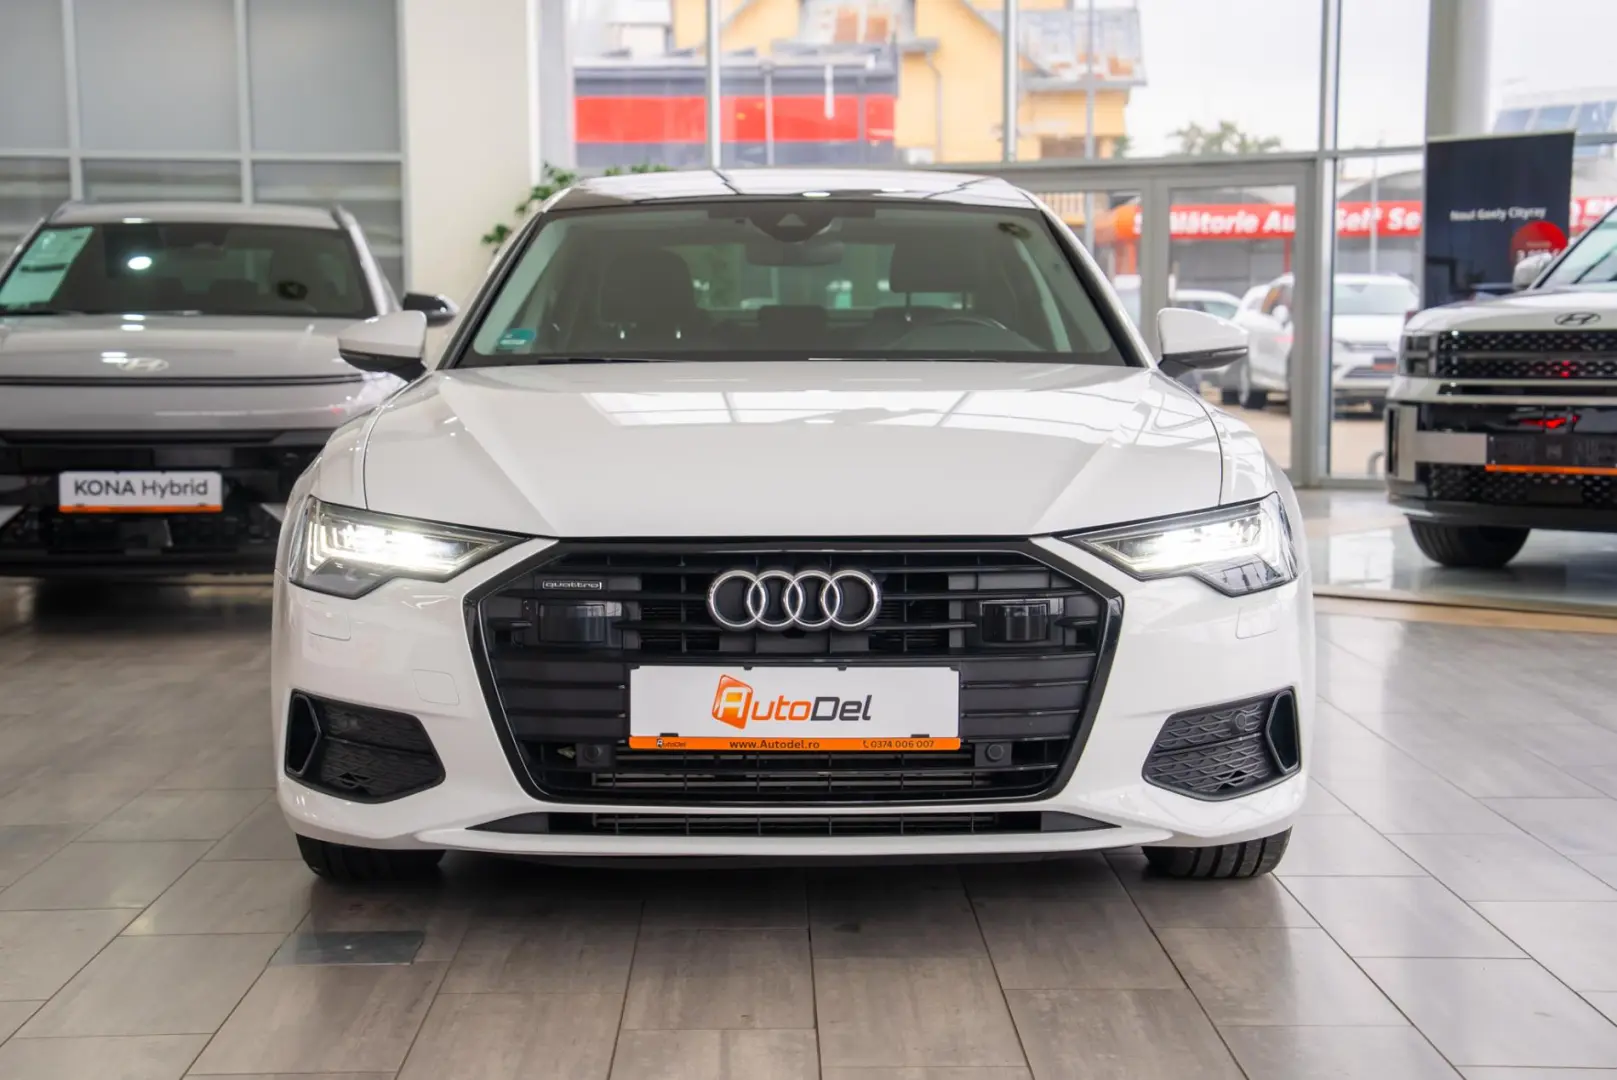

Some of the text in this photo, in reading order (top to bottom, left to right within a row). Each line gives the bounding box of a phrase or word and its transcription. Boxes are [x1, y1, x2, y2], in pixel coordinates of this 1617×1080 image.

[1263, 209, 1295, 234] Au
[1387, 206, 1421, 232] Se
[74, 479, 208, 499] KONA Hybrid
[544, 581, 600, 590] quattro
[713, 680, 873, 725] AutoDel
[729, 740, 820, 749] www.Autodel.ro
[870, 740, 934, 749] 0374 006 007
